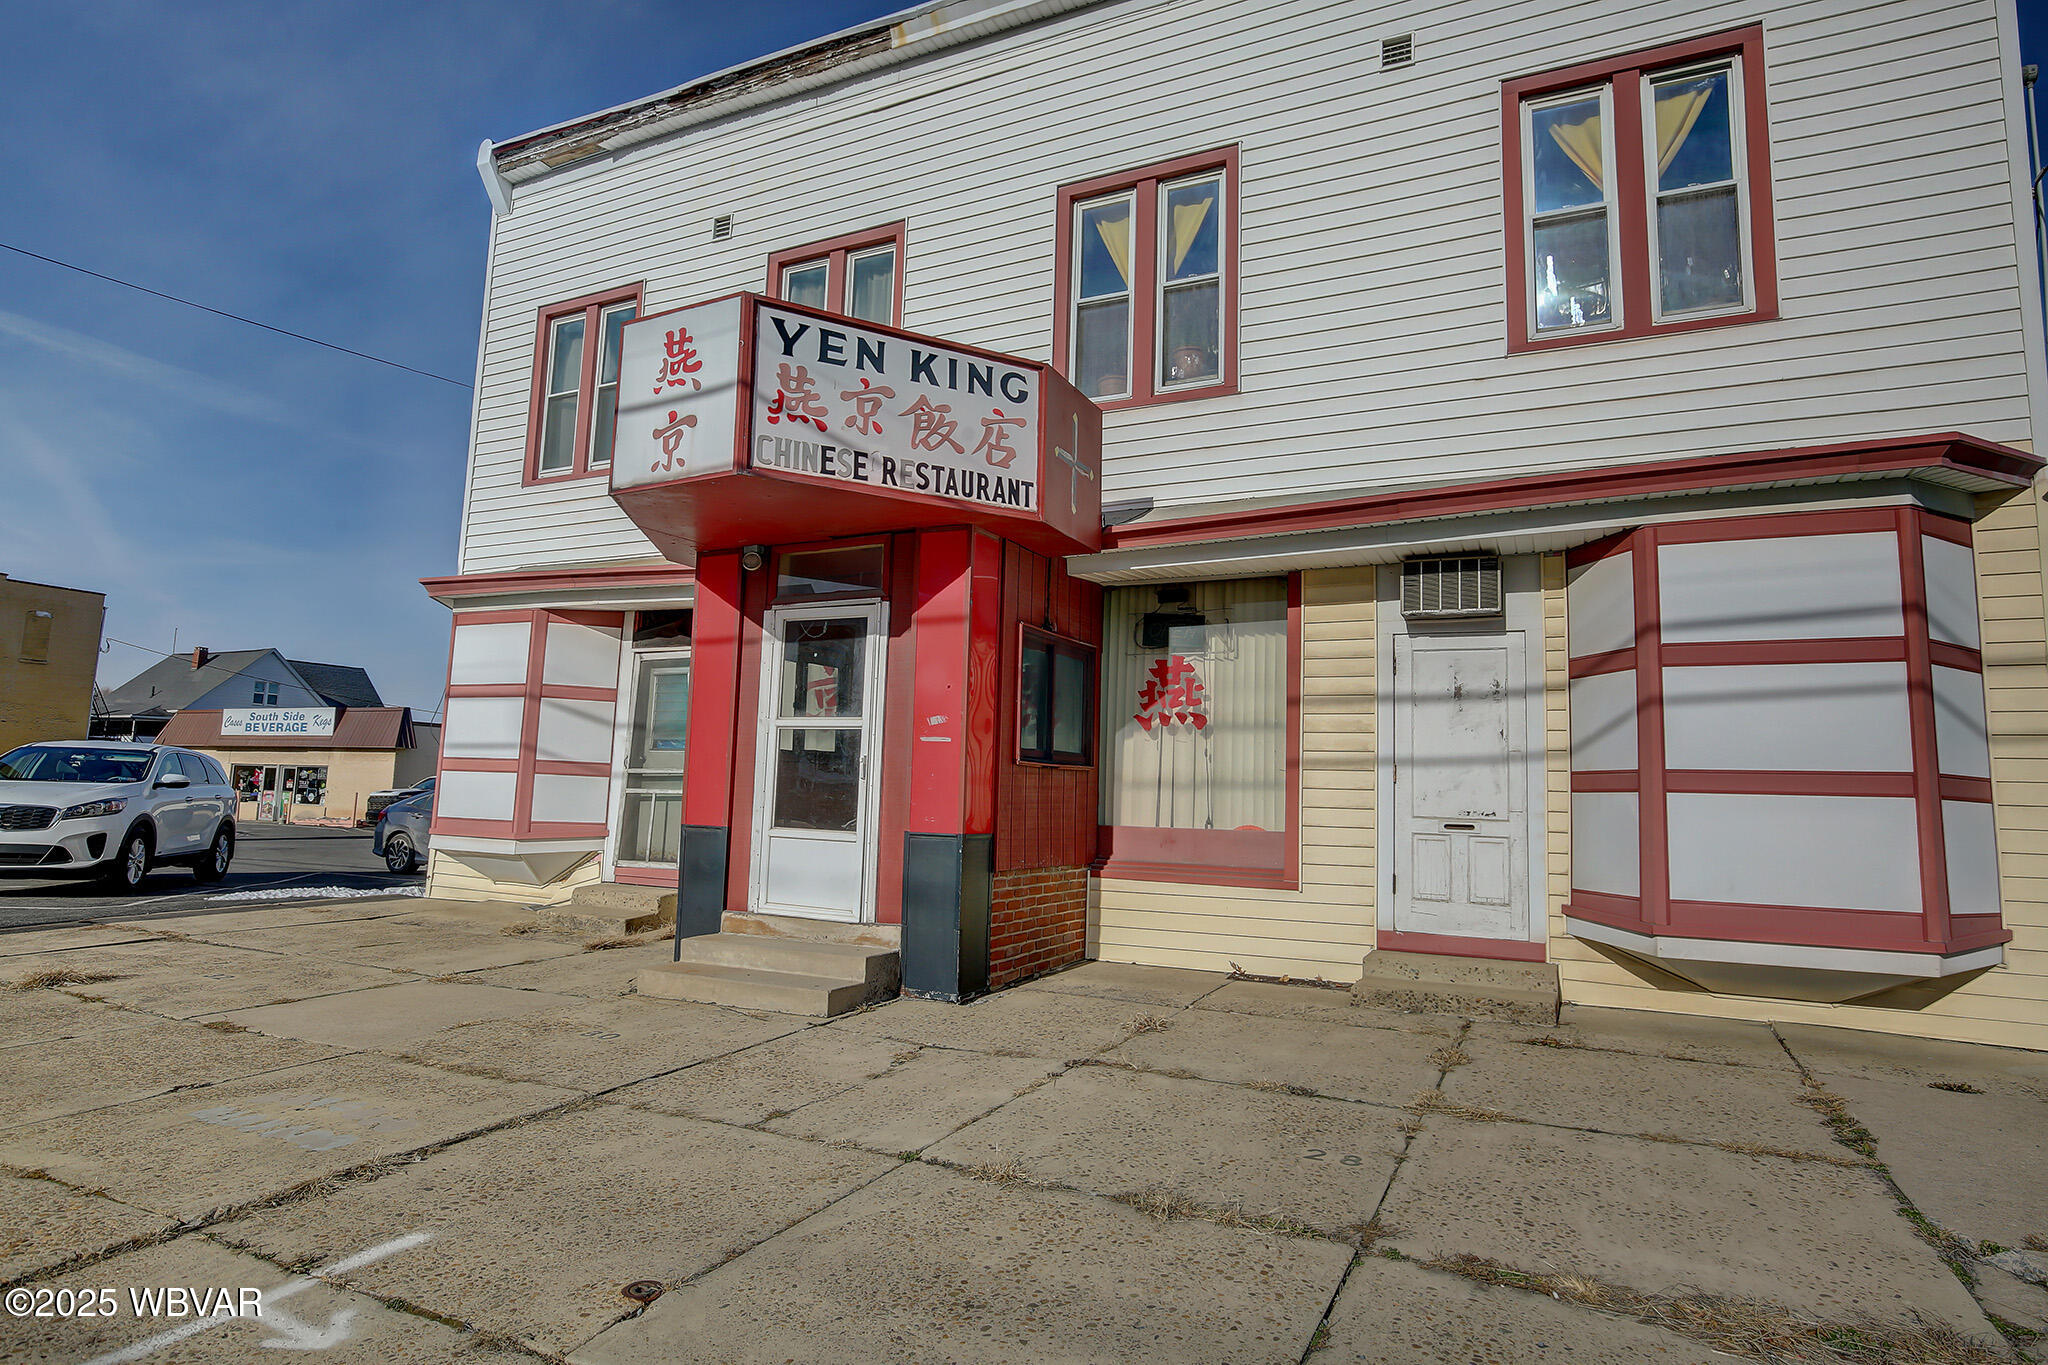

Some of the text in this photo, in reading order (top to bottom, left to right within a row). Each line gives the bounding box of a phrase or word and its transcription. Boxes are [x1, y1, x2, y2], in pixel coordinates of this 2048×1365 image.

[769, 316, 1029, 404] YEN KING
[650, 327, 703, 472] 燕京
[767, 362, 1027, 469] 燕京飯店
[756, 434, 1034, 508] CHINESE RESTAURANT
[245, 722, 308, 732] BEVERAGE
[249, 711, 305, 721] South Side
[312, 714, 332, 730] Kegs
[1302, 1149, 1363, 1167] 28
